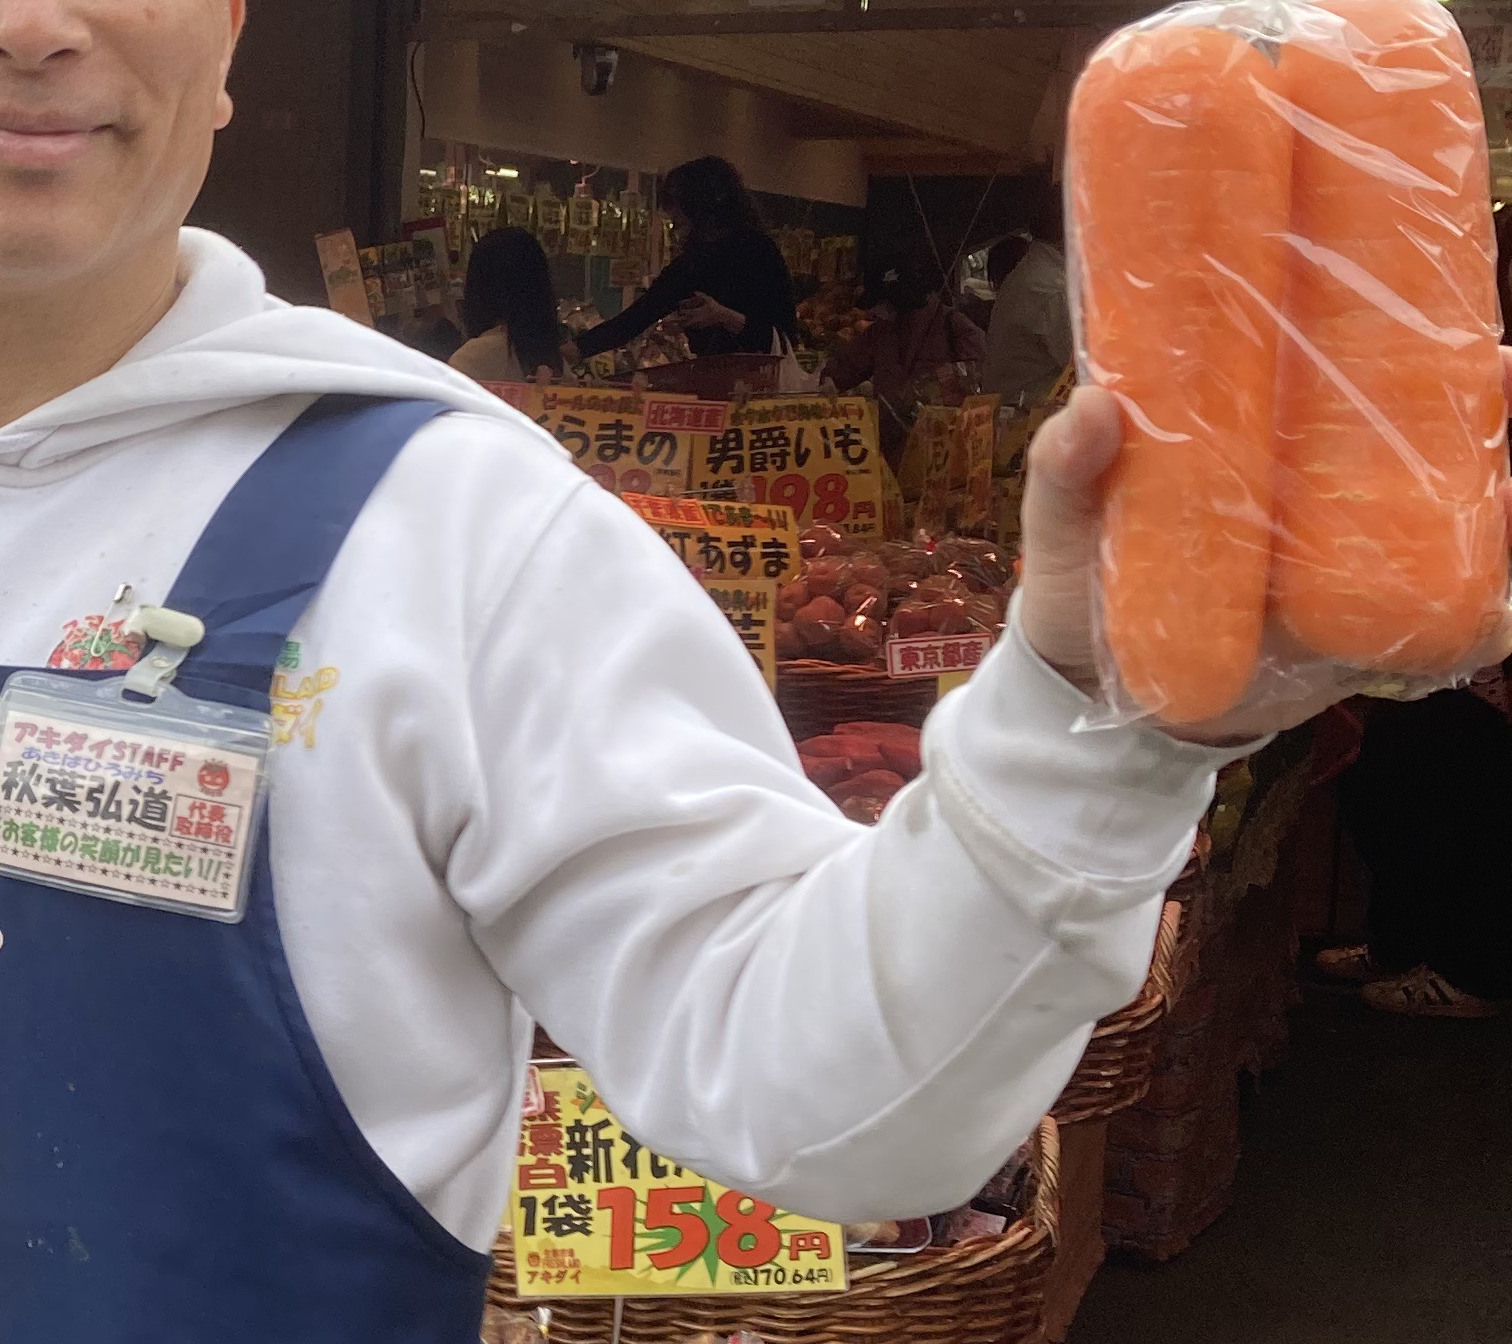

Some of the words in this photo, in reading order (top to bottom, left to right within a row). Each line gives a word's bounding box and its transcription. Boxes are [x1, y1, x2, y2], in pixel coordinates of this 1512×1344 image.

[705, 423, 869, 474] 男爵いも
[899, 640, 984, 672] 東京都産
[0, 759, 173, 833] 秋葉弘道
[520, 1193, 595, 1239] 1袋
[597, 1186, 831, 1272] 158円
